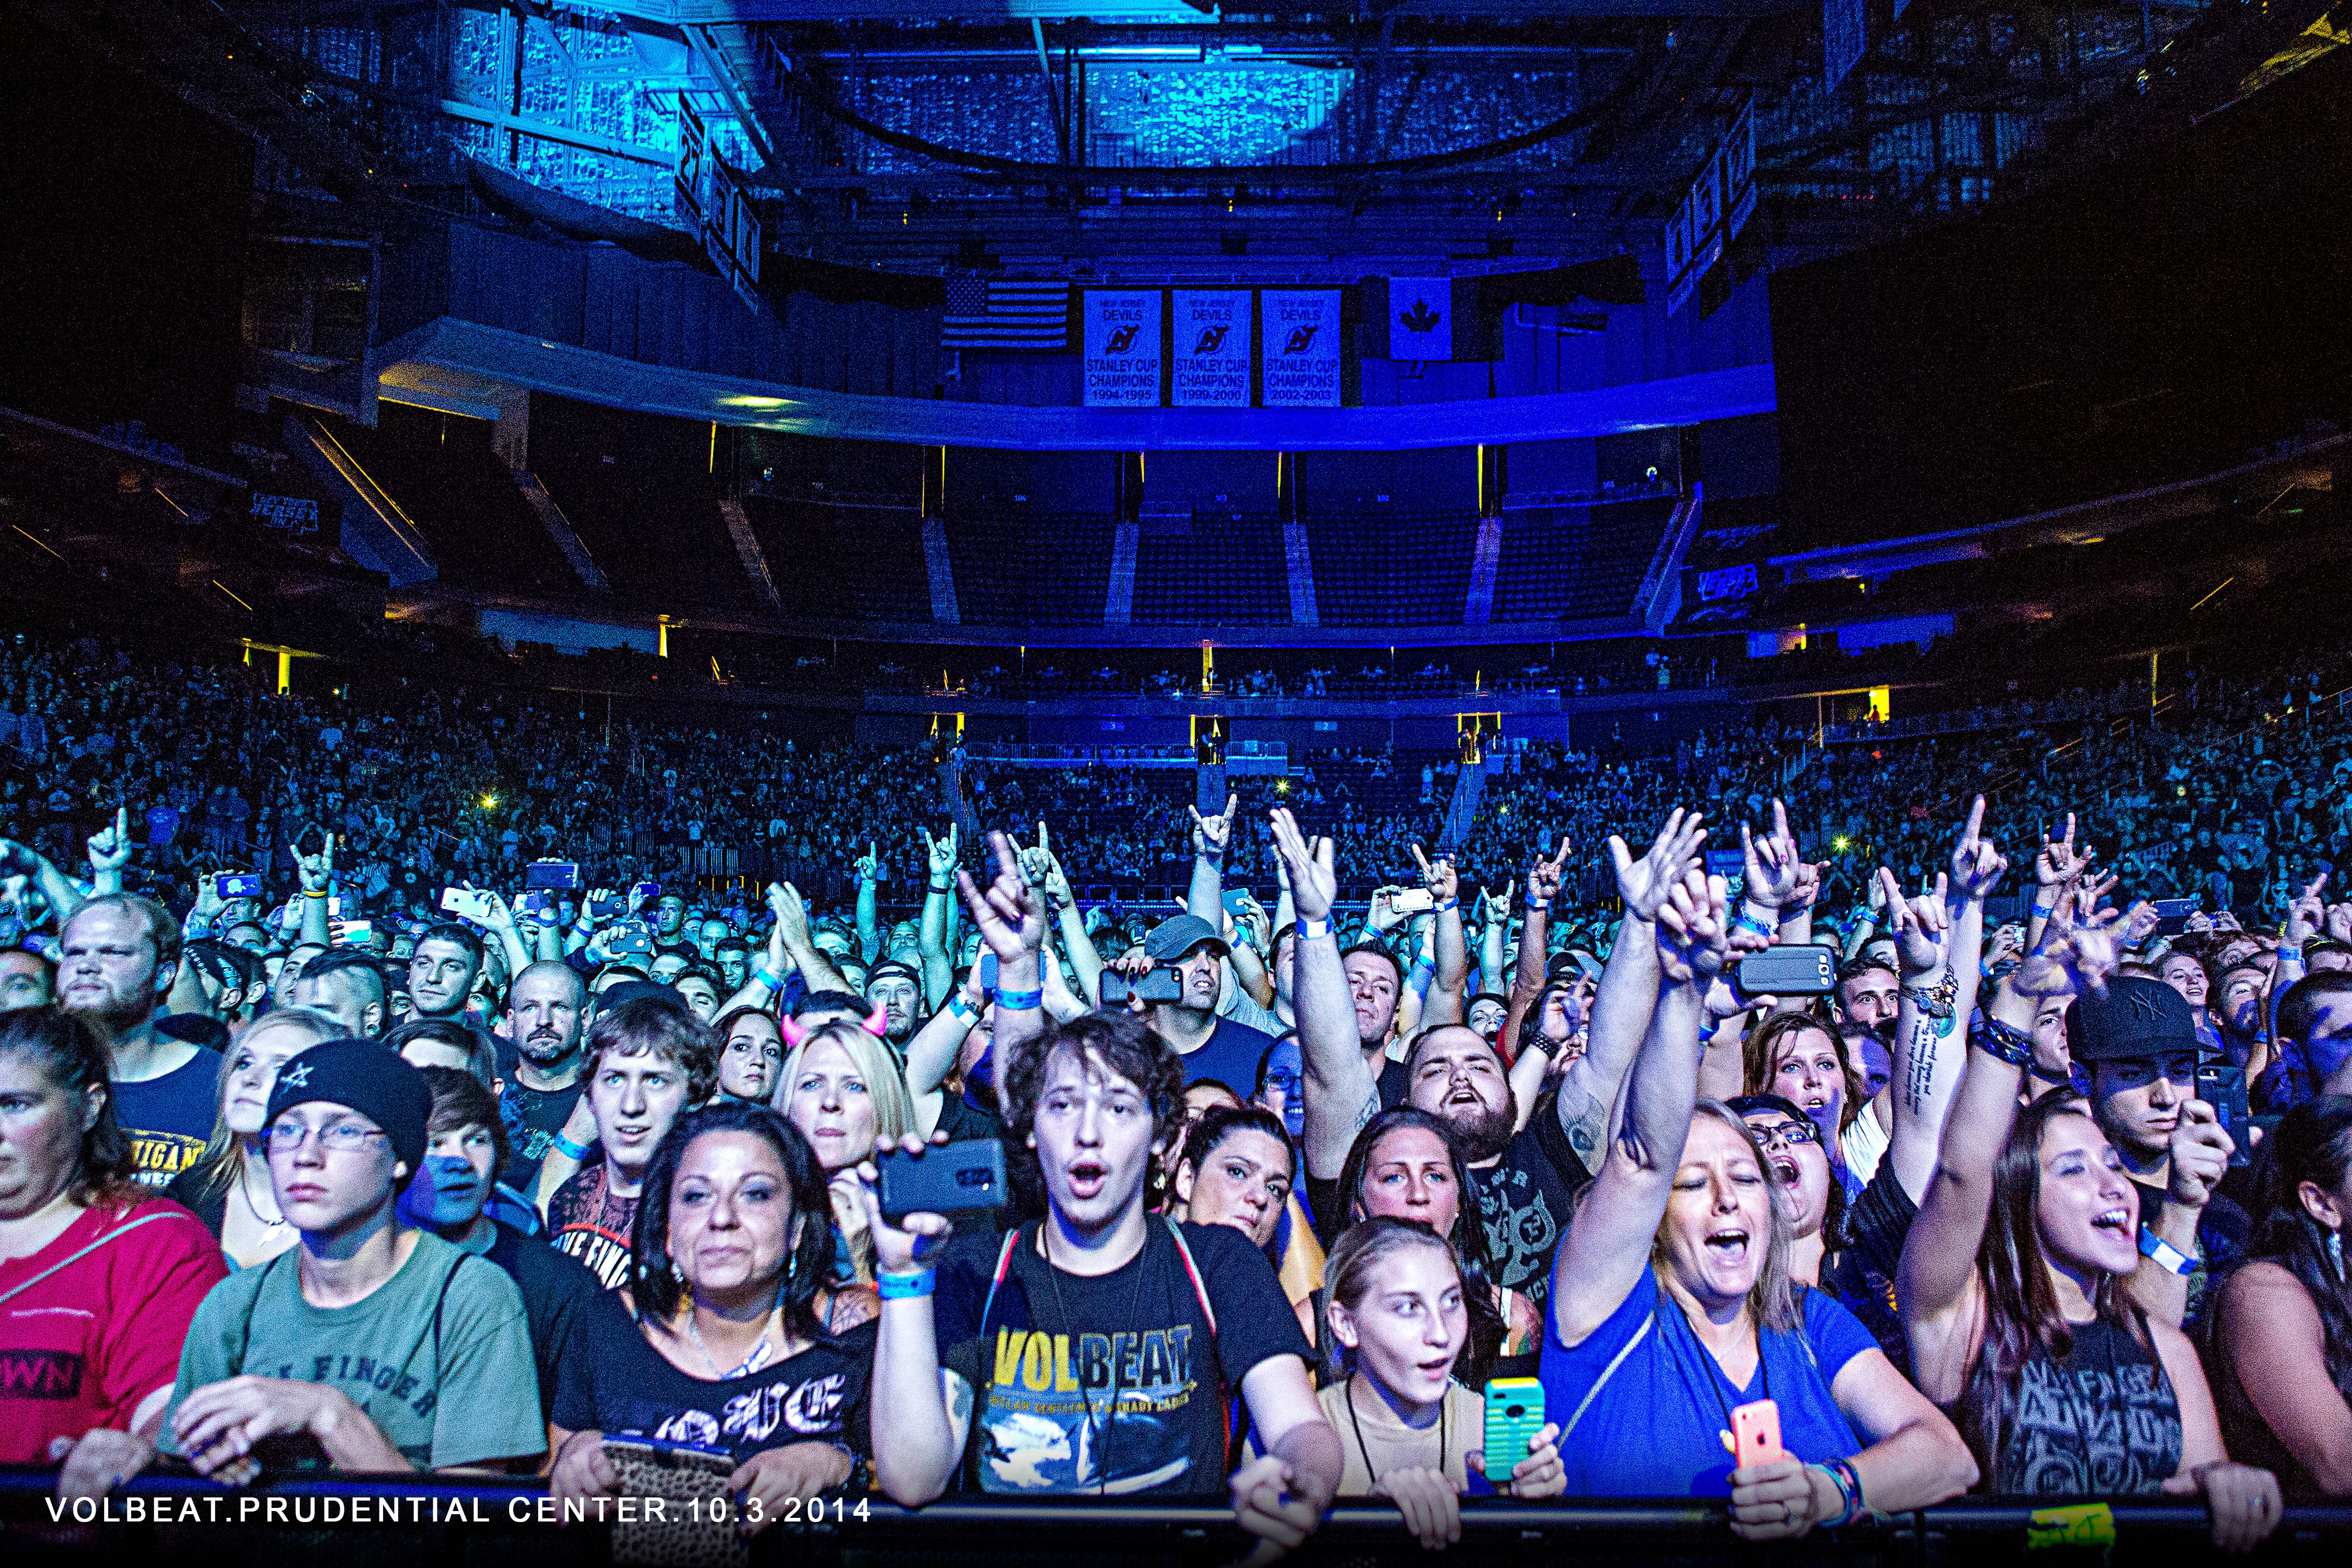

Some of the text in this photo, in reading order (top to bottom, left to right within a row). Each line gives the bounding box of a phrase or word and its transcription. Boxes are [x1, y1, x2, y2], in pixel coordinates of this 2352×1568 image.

[1104, 310, 1142, 320] DEVILS
[1193, 310, 1231, 320] DEVILS
[1282, 310, 1321, 320] DEVILS
[1087, 359, 1157, 372] STANLEY CUP
[1175, 359, 1247, 372] STANLEY CUP
[1266, 359, 1337, 372] STANLEY CUP
[1090, 374, 1154, 387] CHAMPIONS
[1179, 374, 1244, 387] CHAMPIONS
[1270, 374, 1334, 387] CHAMPIONS
[1093, 389, 1151, 400] 1994-1995
[1183, 389, 1241, 400] 1999-2000
[1272, 389, 1331, 400] 2002-2003
[583, 1236, 631, 1290] FING
[994, 1324, 1192, 1392] VOLBEAT
[0, 1357, 73, 1391] WN
[315, 1355, 437, 1417] FINGER
